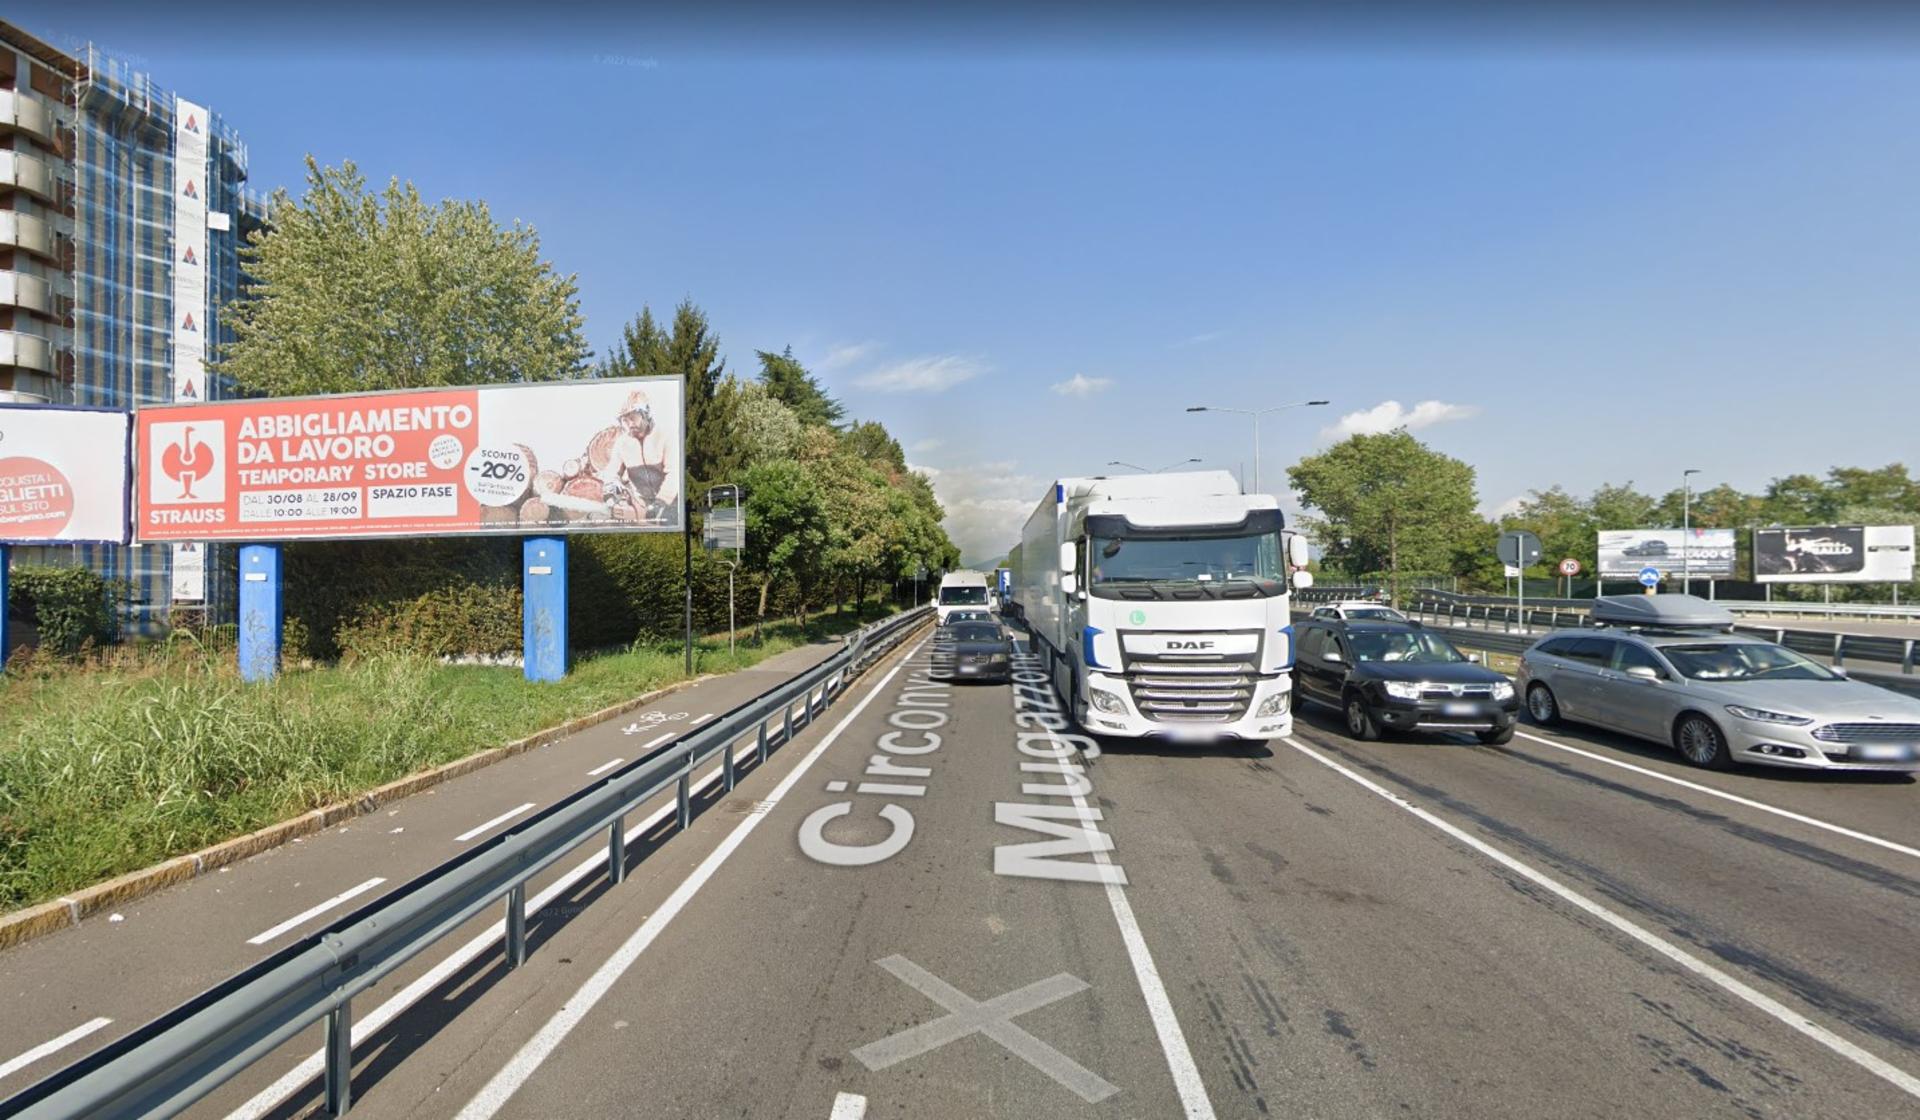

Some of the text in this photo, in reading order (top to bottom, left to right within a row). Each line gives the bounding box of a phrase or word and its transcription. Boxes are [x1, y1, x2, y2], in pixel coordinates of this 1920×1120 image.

[238, 404, 473, 440] ABBIGLIAMENTO
[237, 434, 395, 465] DA LAVORO
[481, 449, 520, 461] SCONTO
[238, 461, 428, 486] TEMPORARY STORE
[243, 491, 358, 506] DAL 30/08 AL 28/09
[372, 486, 452, 500] SPAZIO FASE
[22, 500, 50, 512] SITO
[150, 507, 226, 524] STRAUSS
[1166, 641, 1215, 650] DAF
